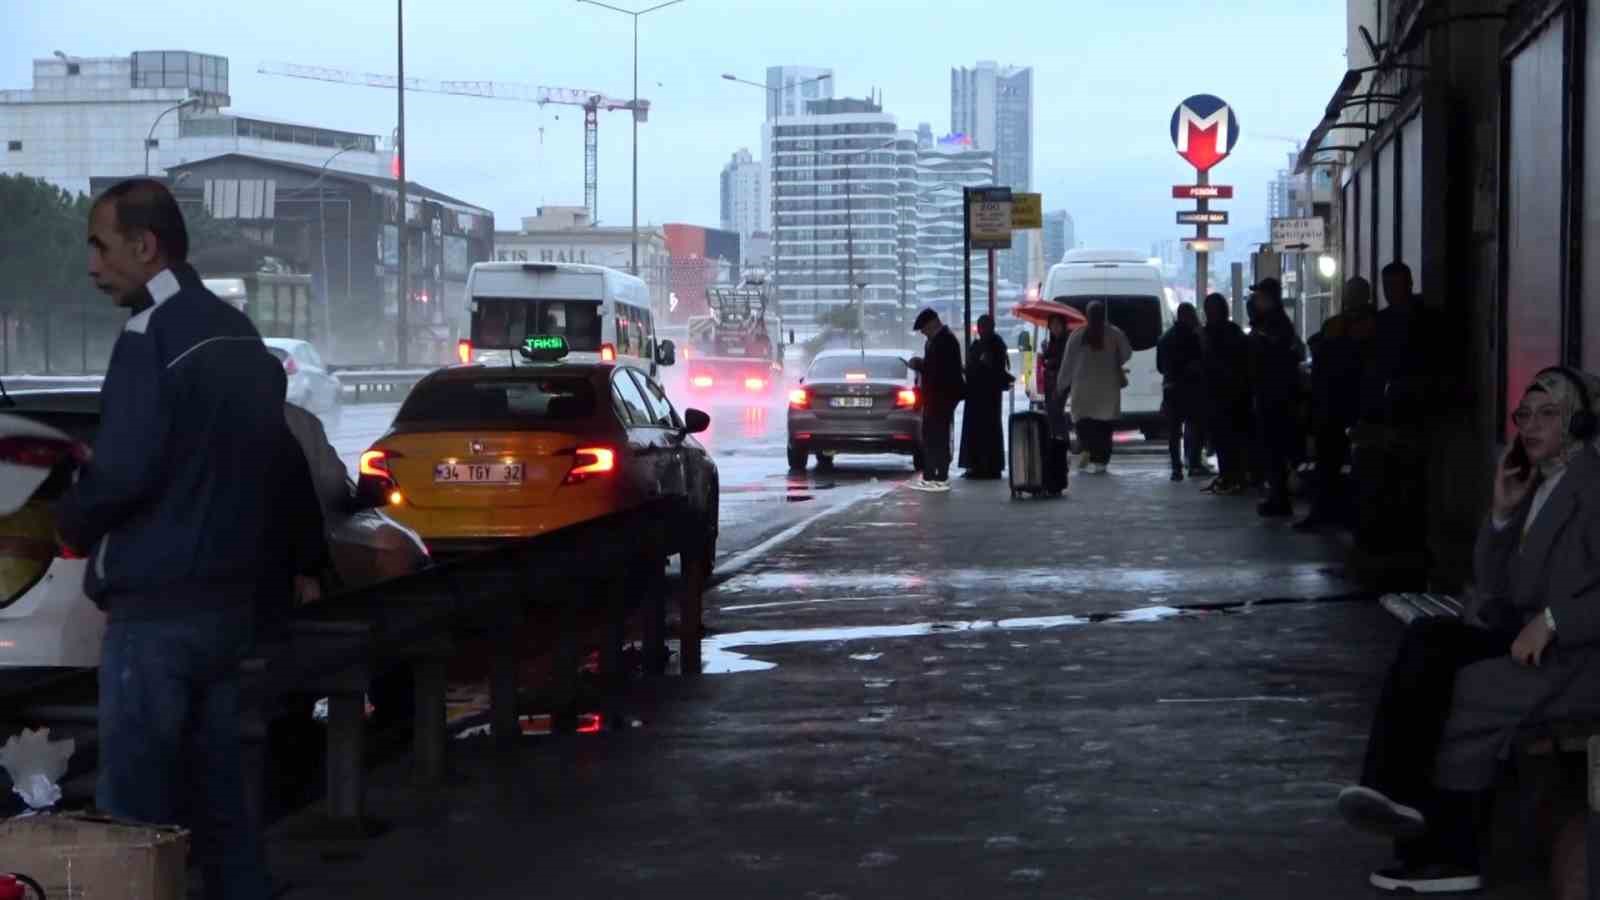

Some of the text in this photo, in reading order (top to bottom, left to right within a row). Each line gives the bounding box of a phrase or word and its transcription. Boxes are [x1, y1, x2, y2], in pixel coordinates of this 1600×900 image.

[1177, 103, 1229, 153] M
[444, 465, 520, 480] 34 TGY 32
